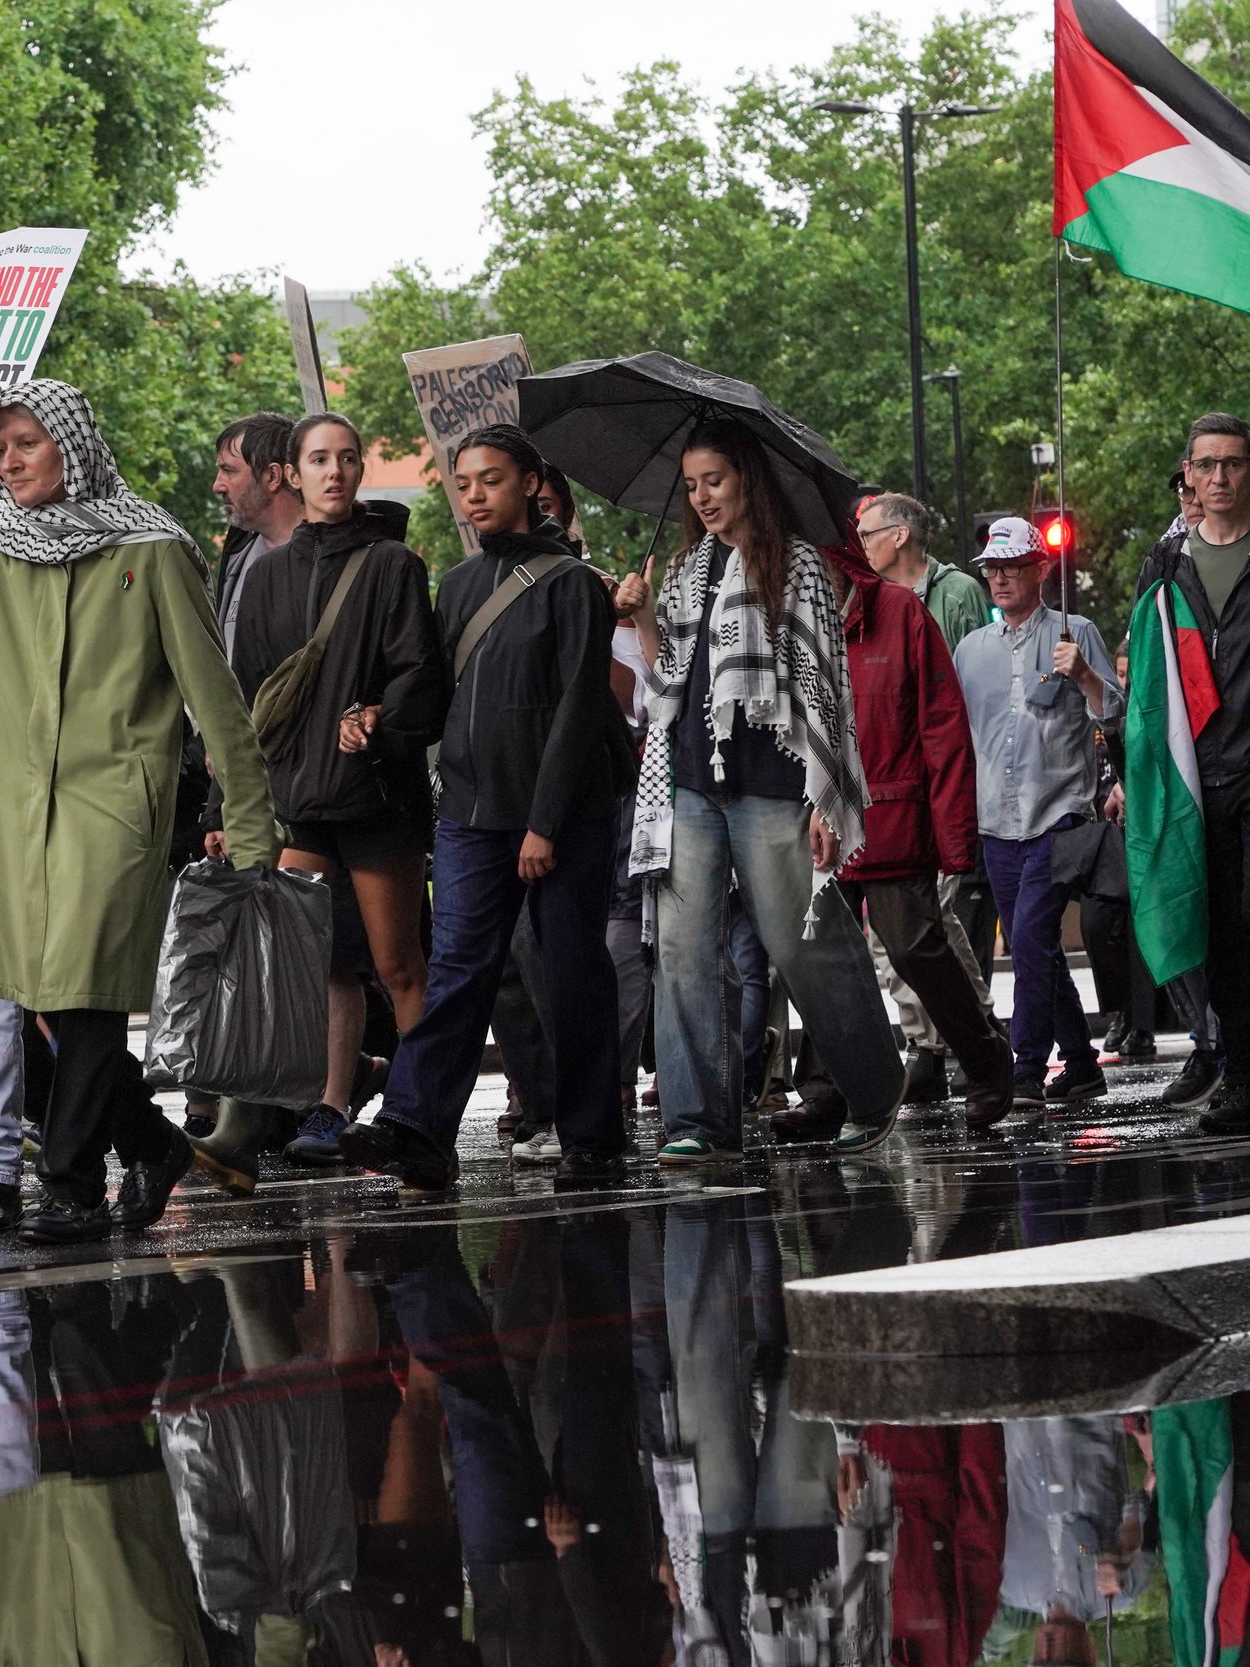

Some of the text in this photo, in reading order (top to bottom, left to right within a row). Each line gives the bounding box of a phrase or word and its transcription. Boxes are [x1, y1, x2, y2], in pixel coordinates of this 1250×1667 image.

[16, 244, 33, 254] War
[33, 244, 72, 255] coalition
[17, 266, 64, 308] THE
[2, 309, 46, 362] TO
